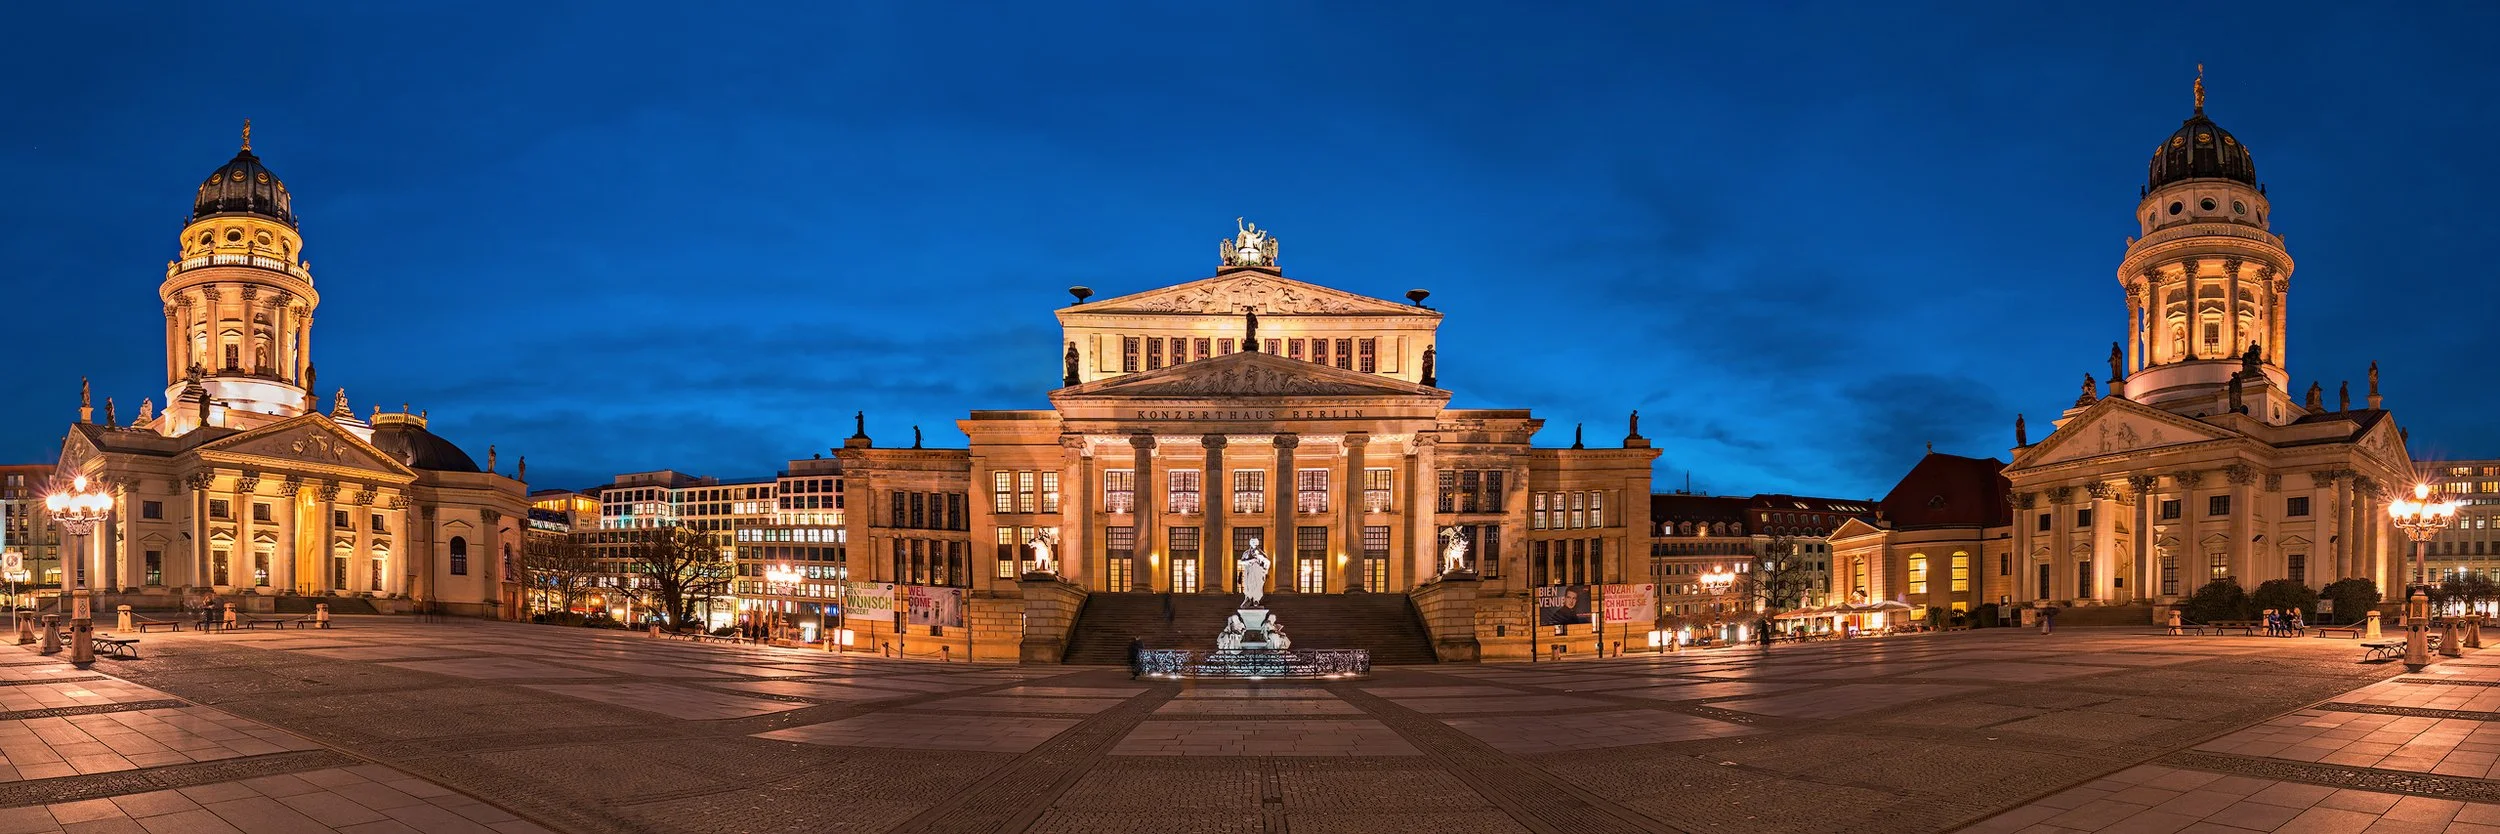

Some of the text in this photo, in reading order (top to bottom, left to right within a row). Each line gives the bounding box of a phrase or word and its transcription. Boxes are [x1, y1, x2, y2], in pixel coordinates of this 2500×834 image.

[1137, 410, 1363, 419] KONZERTHAUS BERLIN
[908, 586, 926, 596] WEL
[1539, 586, 1558, 596] BIEN
[908, 597, 932, 607] COME
[1539, 597, 1565, 607] VENUE
[1616, 599, 1636, 607] HATTE
[1605, 608, 1632, 620] ALLE.
